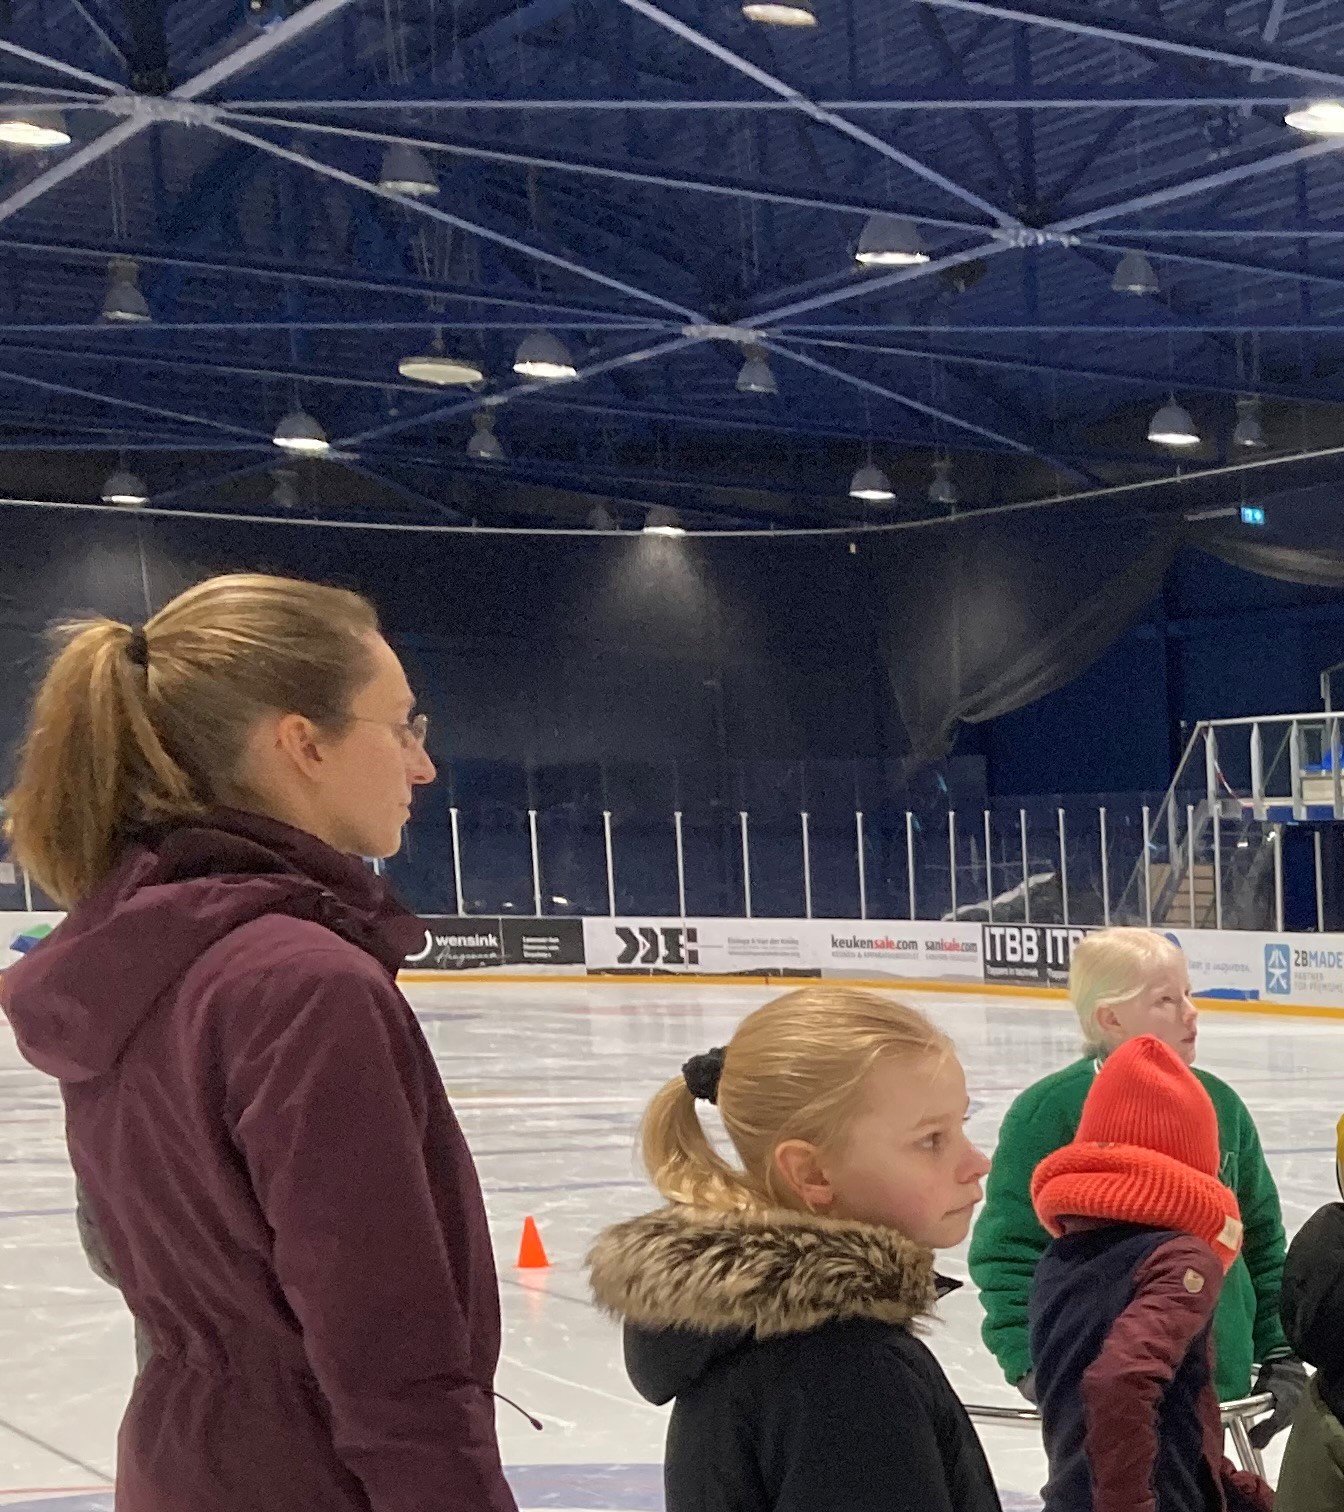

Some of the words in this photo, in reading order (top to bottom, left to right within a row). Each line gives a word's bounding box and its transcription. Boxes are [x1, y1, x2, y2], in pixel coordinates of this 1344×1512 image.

[435, 933, 498, 947] wensink
[831, 934, 918, 951] keukensale.com
[984, 927, 1039, 963] ITBB
[1294, 949, 1344, 969] 2BMADE
